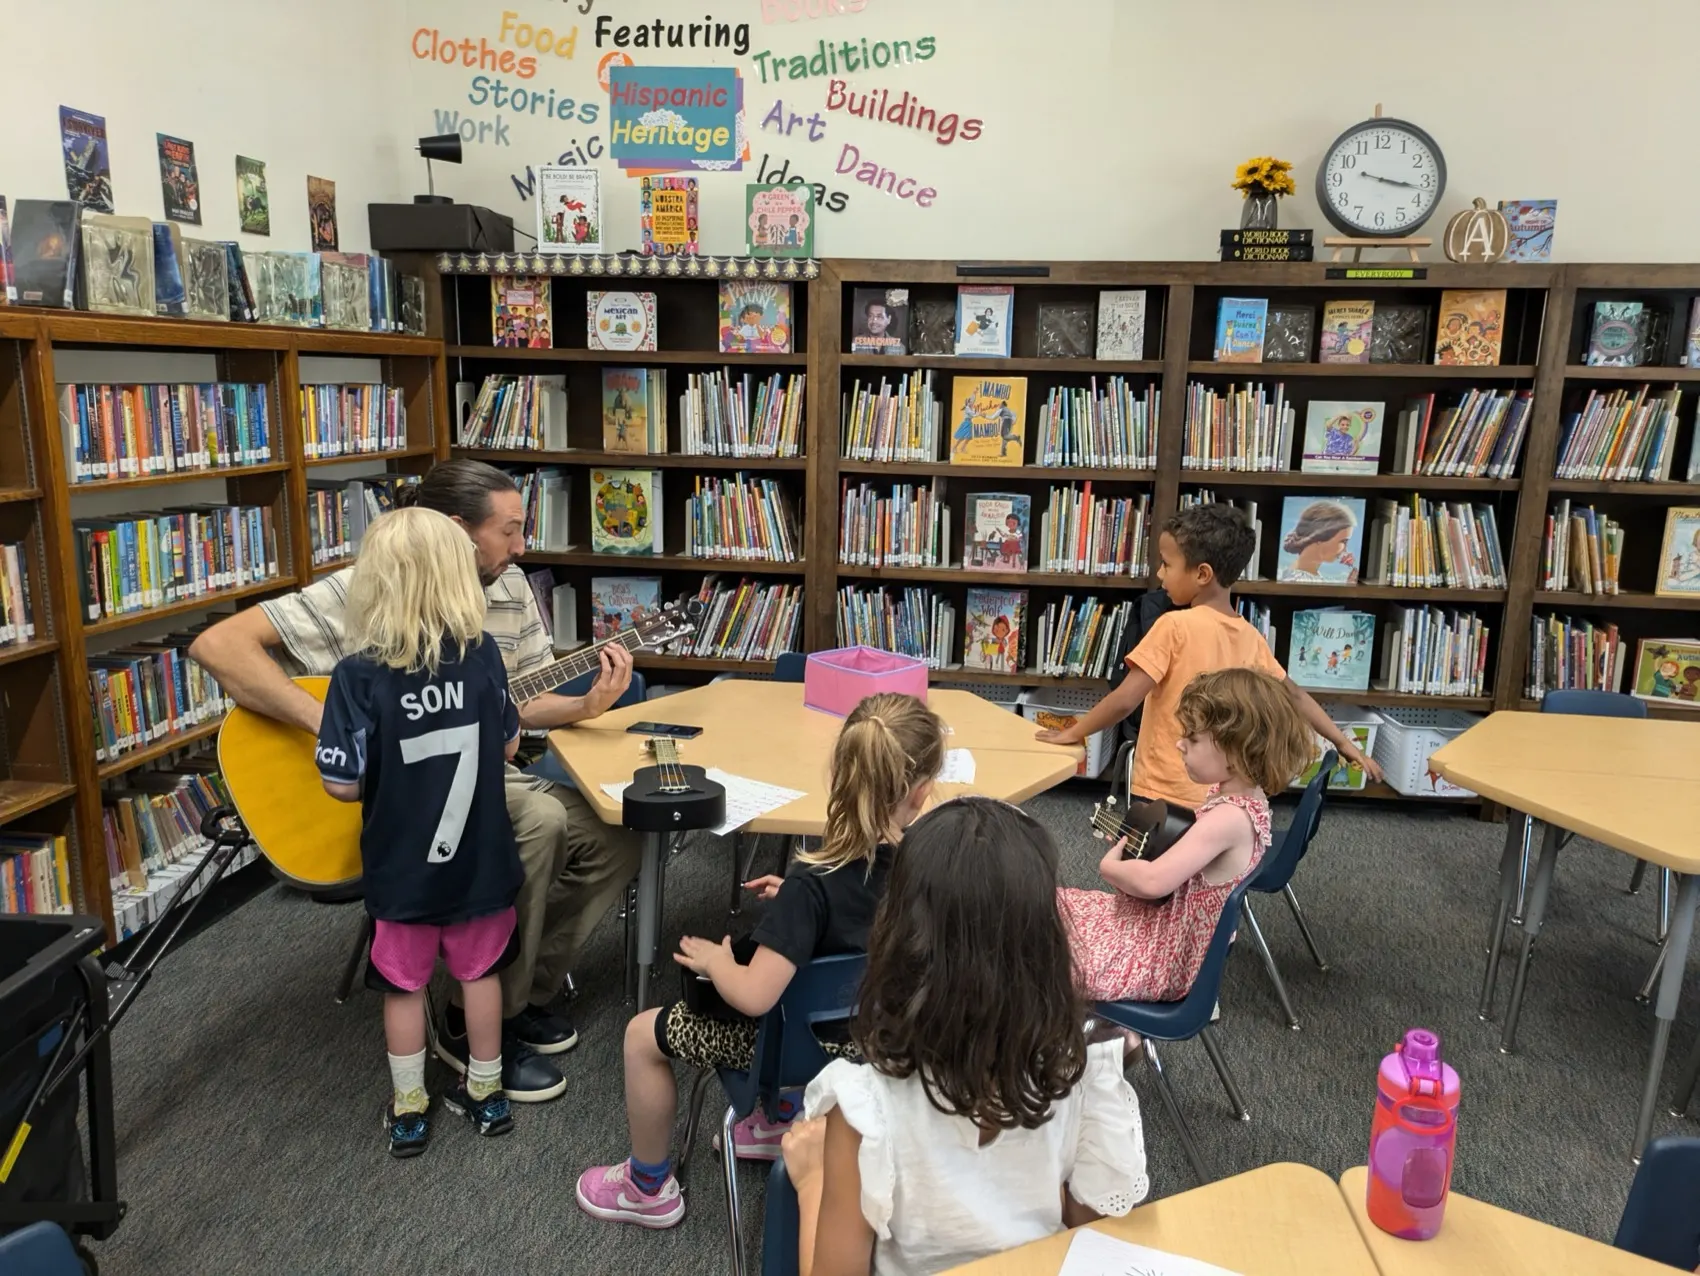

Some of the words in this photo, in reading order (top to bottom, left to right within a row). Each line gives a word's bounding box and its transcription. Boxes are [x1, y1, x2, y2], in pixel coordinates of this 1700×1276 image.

[499, 11, 578, 60] Food
[595, 15, 750, 55] Featuring
[412, 28, 537, 79] Clothes
[752, 36, 936, 84] Traditions
[468, 76, 600, 124] Stories
[611, 82, 728, 112] Hispanic
[825, 79, 984, 145] Buildings
[434, 108, 510, 146] Work
[611, 115, 729, 153] Heritage
[760, 99, 827, 142] Art
[1355, 140, 1368, 155] 11
[1373, 134, 1392, 150] 12
[1400, 140, 1407, 154] 1
[511, 135, 604, 201] Msic
[834, 143, 937, 207] Dance
[1340, 154, 1356, 169] 10
[1412, 154, 1423, 168] 2
[1332, 172, 1343, 187] 9
[1420, 173, 1430, 188] 3
[1338, 192, 1348, 207] 8
[1354, 205, 1364, 221] 7
[1395, 207, 1406, 222] 5
[1411, 193, 1421, 207] 4
[1374, 211, 1384, 226] 6
[1269, 230, 1290, 238] BOOK
[1459, 217, 1495, 256] A
[981, 603, 1003, 618] Wolf
[400, 681, 464, 721] SON
[400, 721, 480, 863] 7
